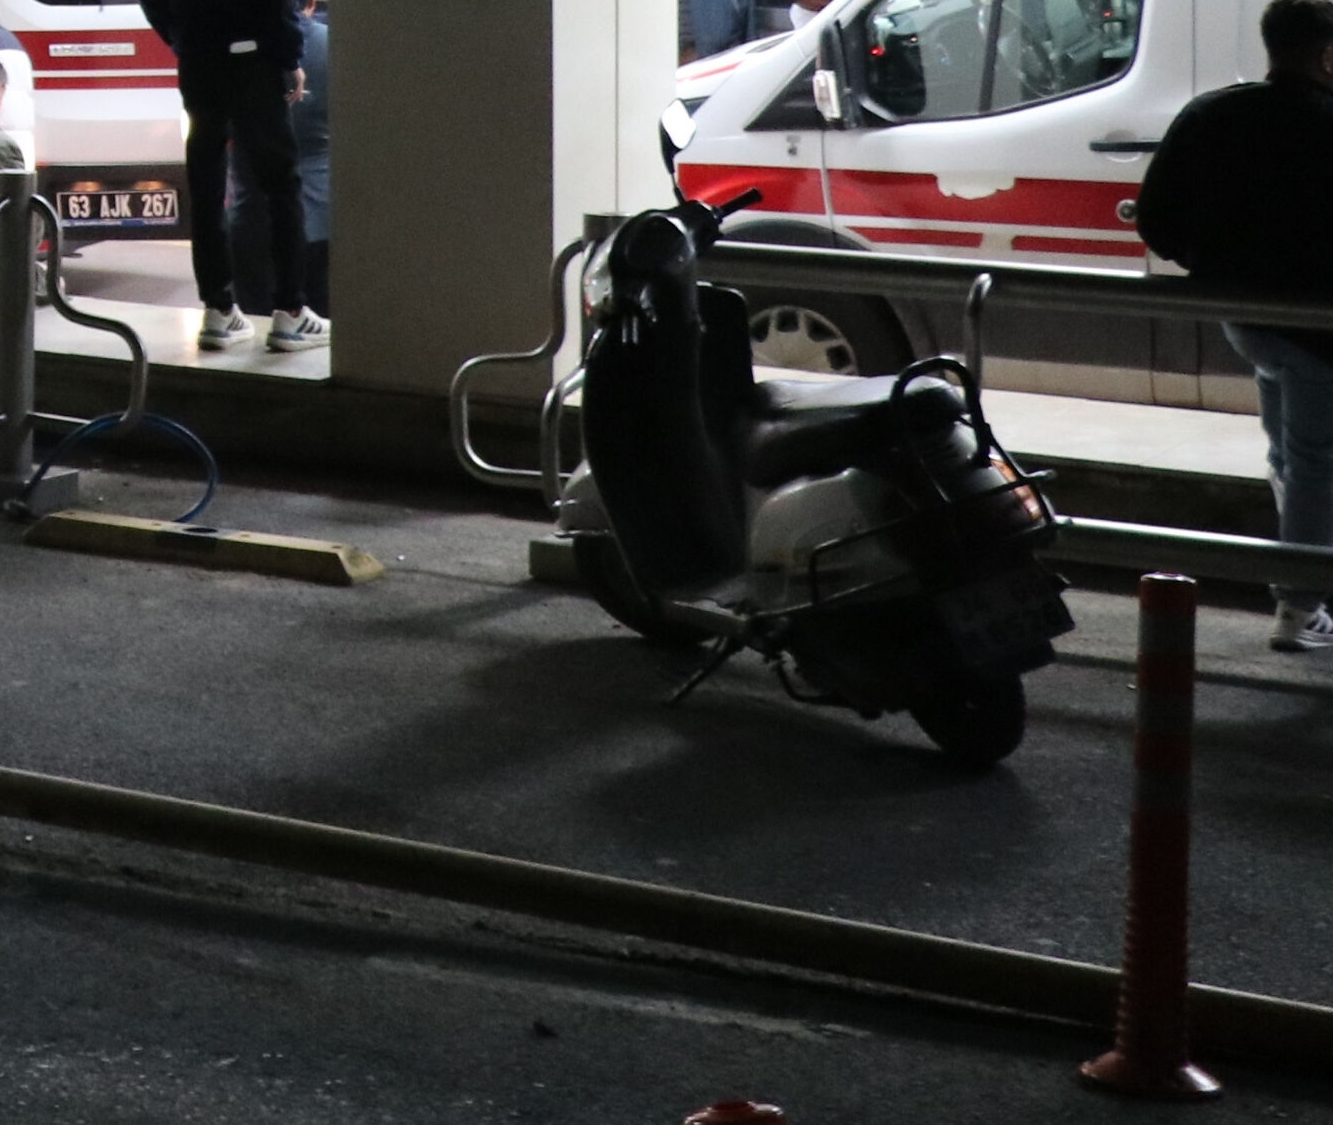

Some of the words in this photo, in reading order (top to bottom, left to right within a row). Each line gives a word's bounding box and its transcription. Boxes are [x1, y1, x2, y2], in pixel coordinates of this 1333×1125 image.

[68, 195, 89, 218] 63
[100, 194, 132, 218] AJK
[141, 193, 174, 216] 267
